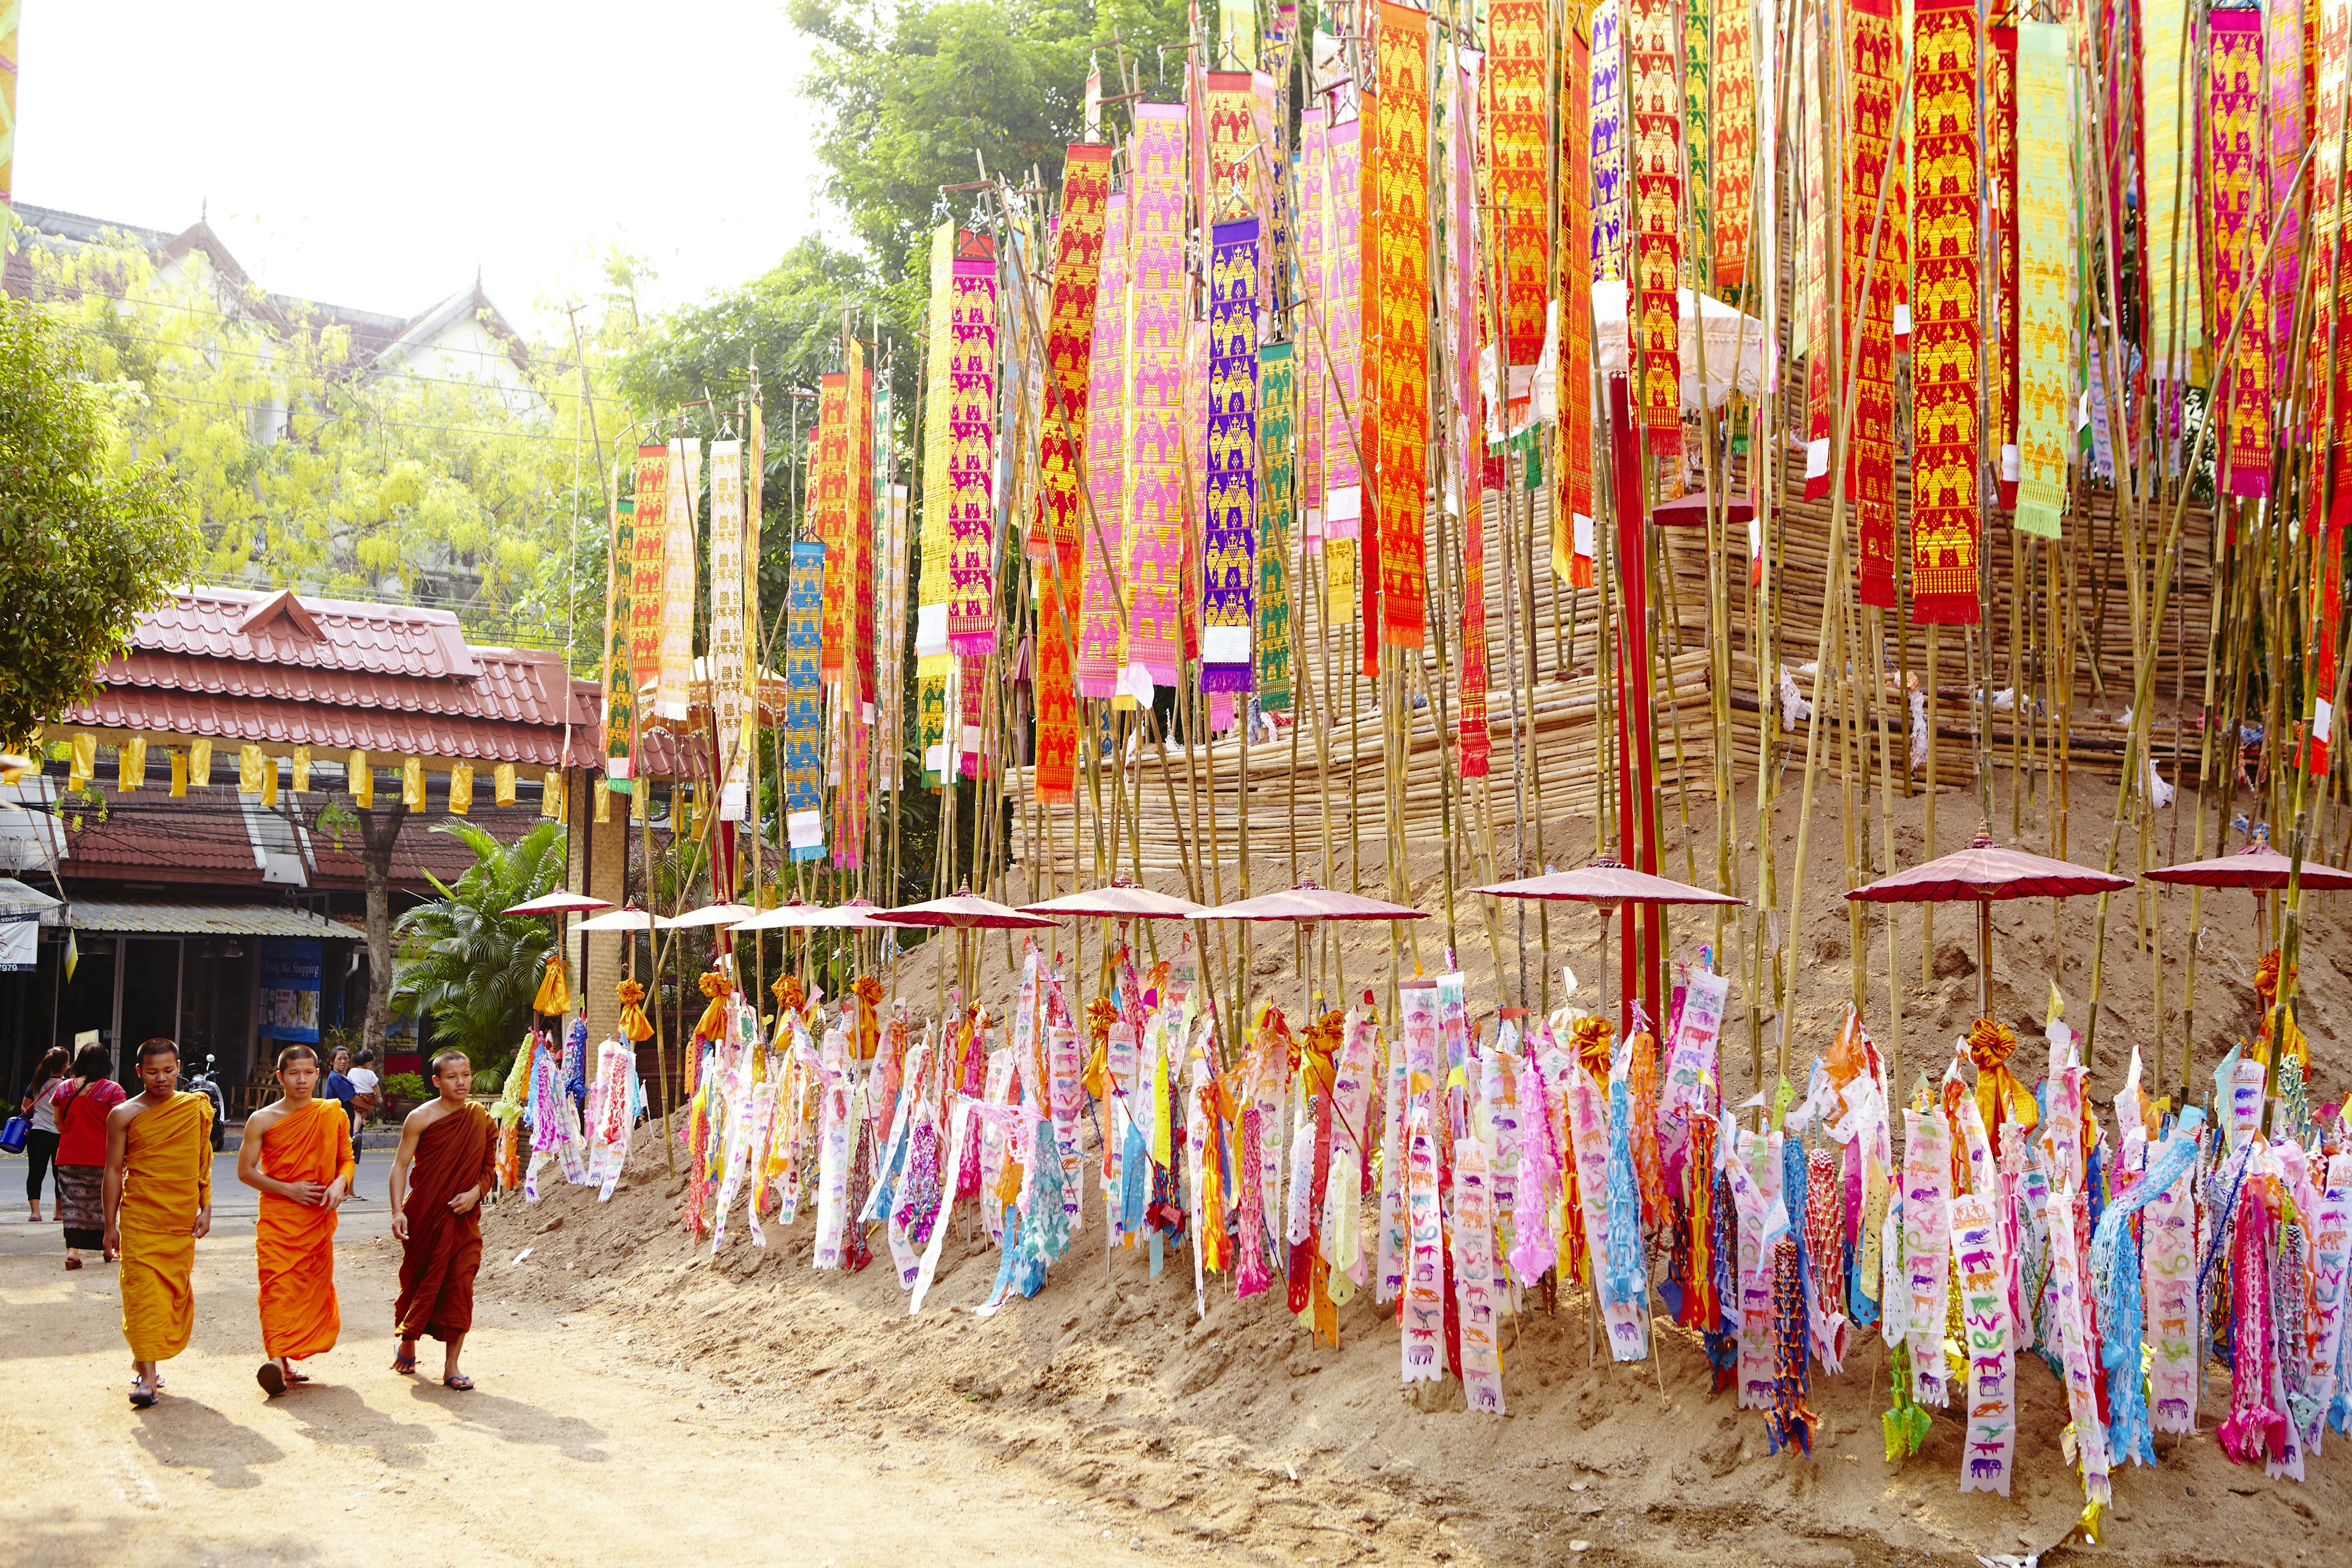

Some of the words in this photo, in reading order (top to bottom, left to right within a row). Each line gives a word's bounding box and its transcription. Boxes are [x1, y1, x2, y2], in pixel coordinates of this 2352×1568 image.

[263, 960, 279, 975] Chiang
[282, 962, 291, 973] Mai
[293, 962, 319, 978] Shopping
